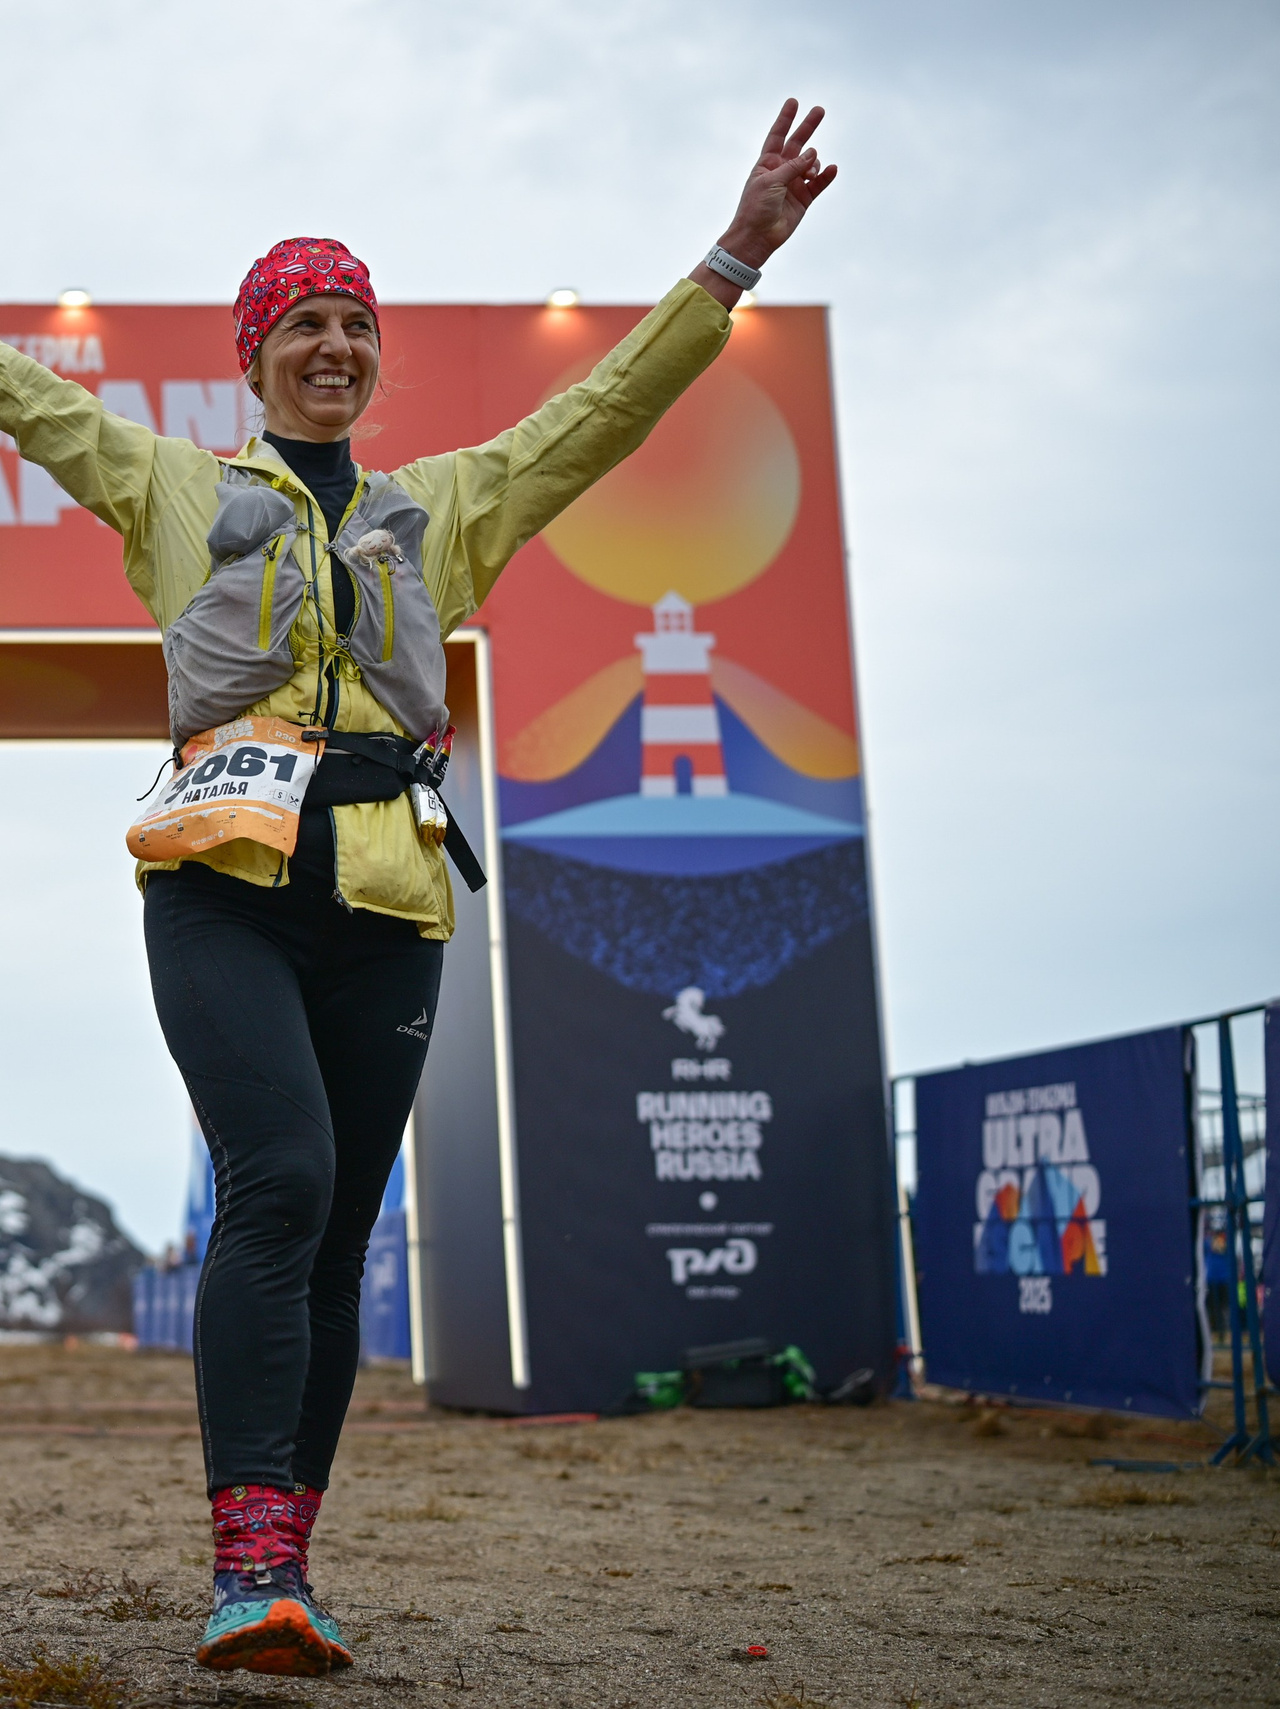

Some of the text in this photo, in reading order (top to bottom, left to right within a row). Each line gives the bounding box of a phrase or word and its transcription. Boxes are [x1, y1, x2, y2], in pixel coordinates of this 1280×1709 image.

[275, 730, 296, 743] R30
[181, 781, 248, 804] НАТАЛЬЯ
[636, 1091, 772, 1123] RUNNING
[650, 1121, 762, 1150] HEROES
[982, 1108, 1090, 1170] ULTRA
[655, 1149, 762, 1182] RUSSIA
